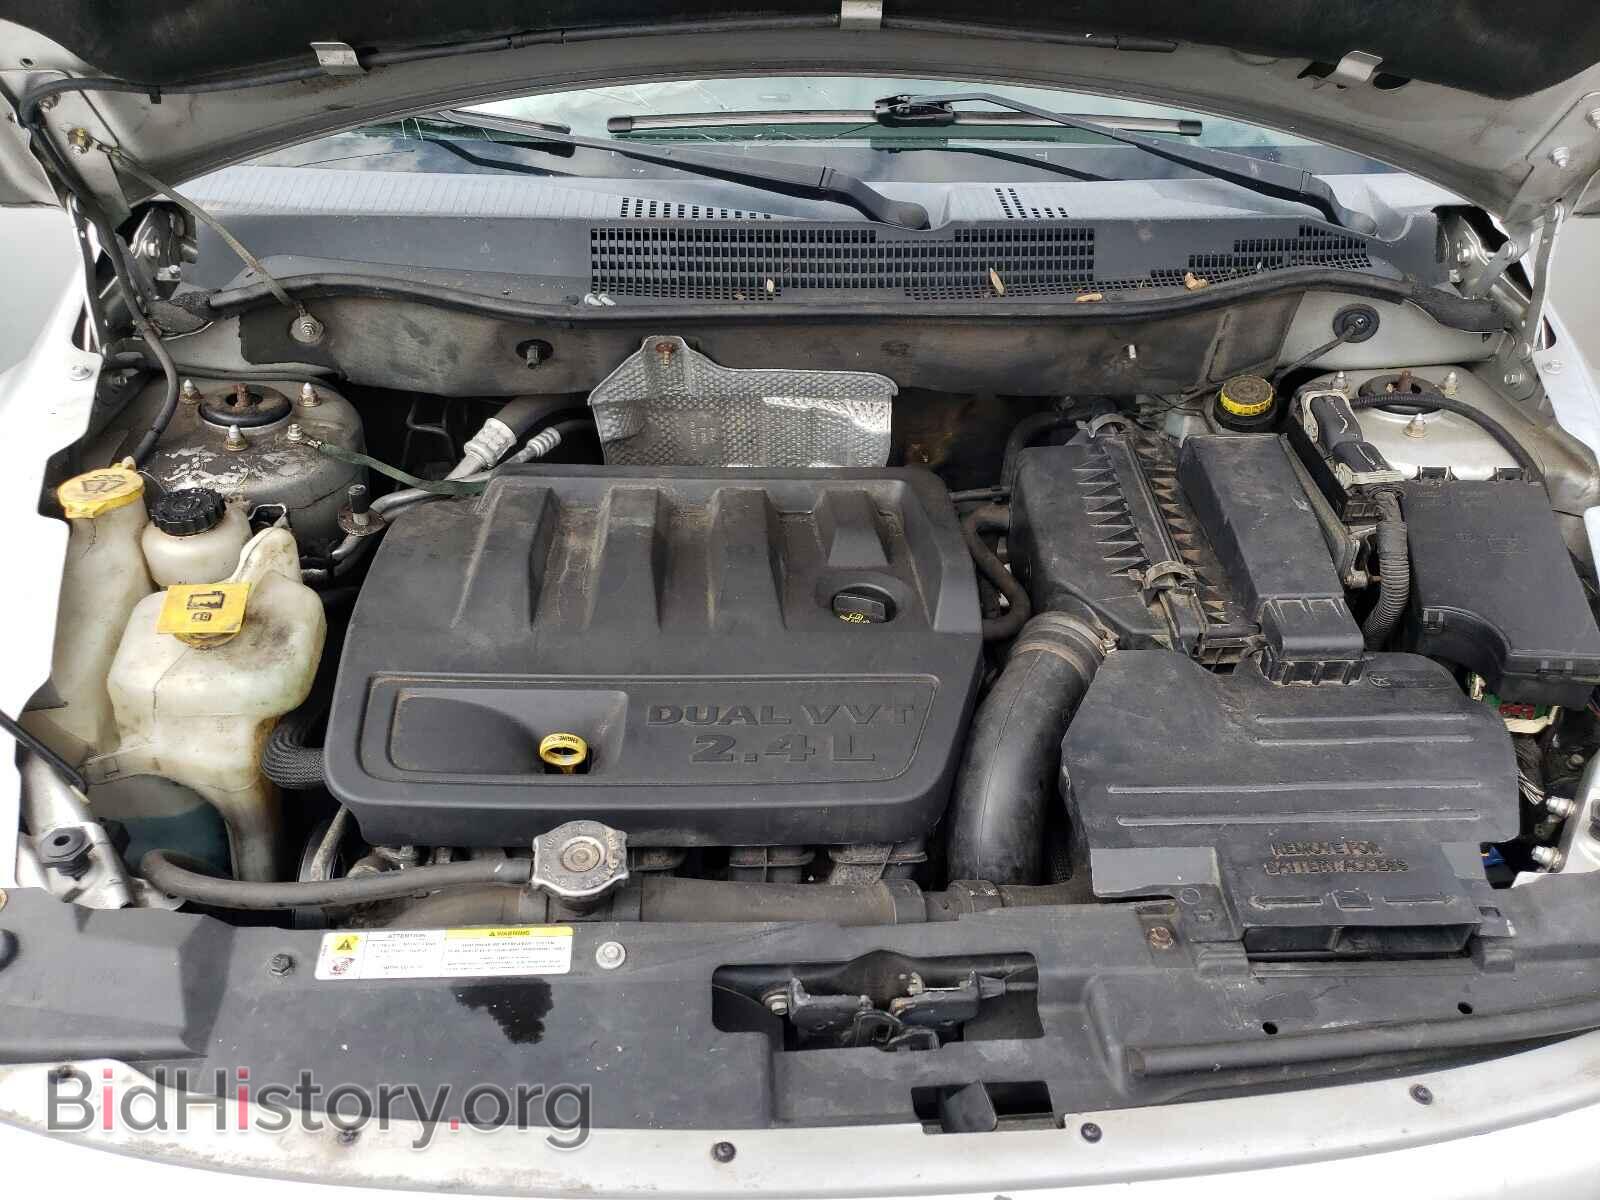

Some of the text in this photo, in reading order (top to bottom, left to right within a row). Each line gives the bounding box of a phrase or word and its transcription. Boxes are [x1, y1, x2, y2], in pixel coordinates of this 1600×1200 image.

[648, 704, 914, 725] DUAL VVT
[690, 734, 875, 762] 2.4L
